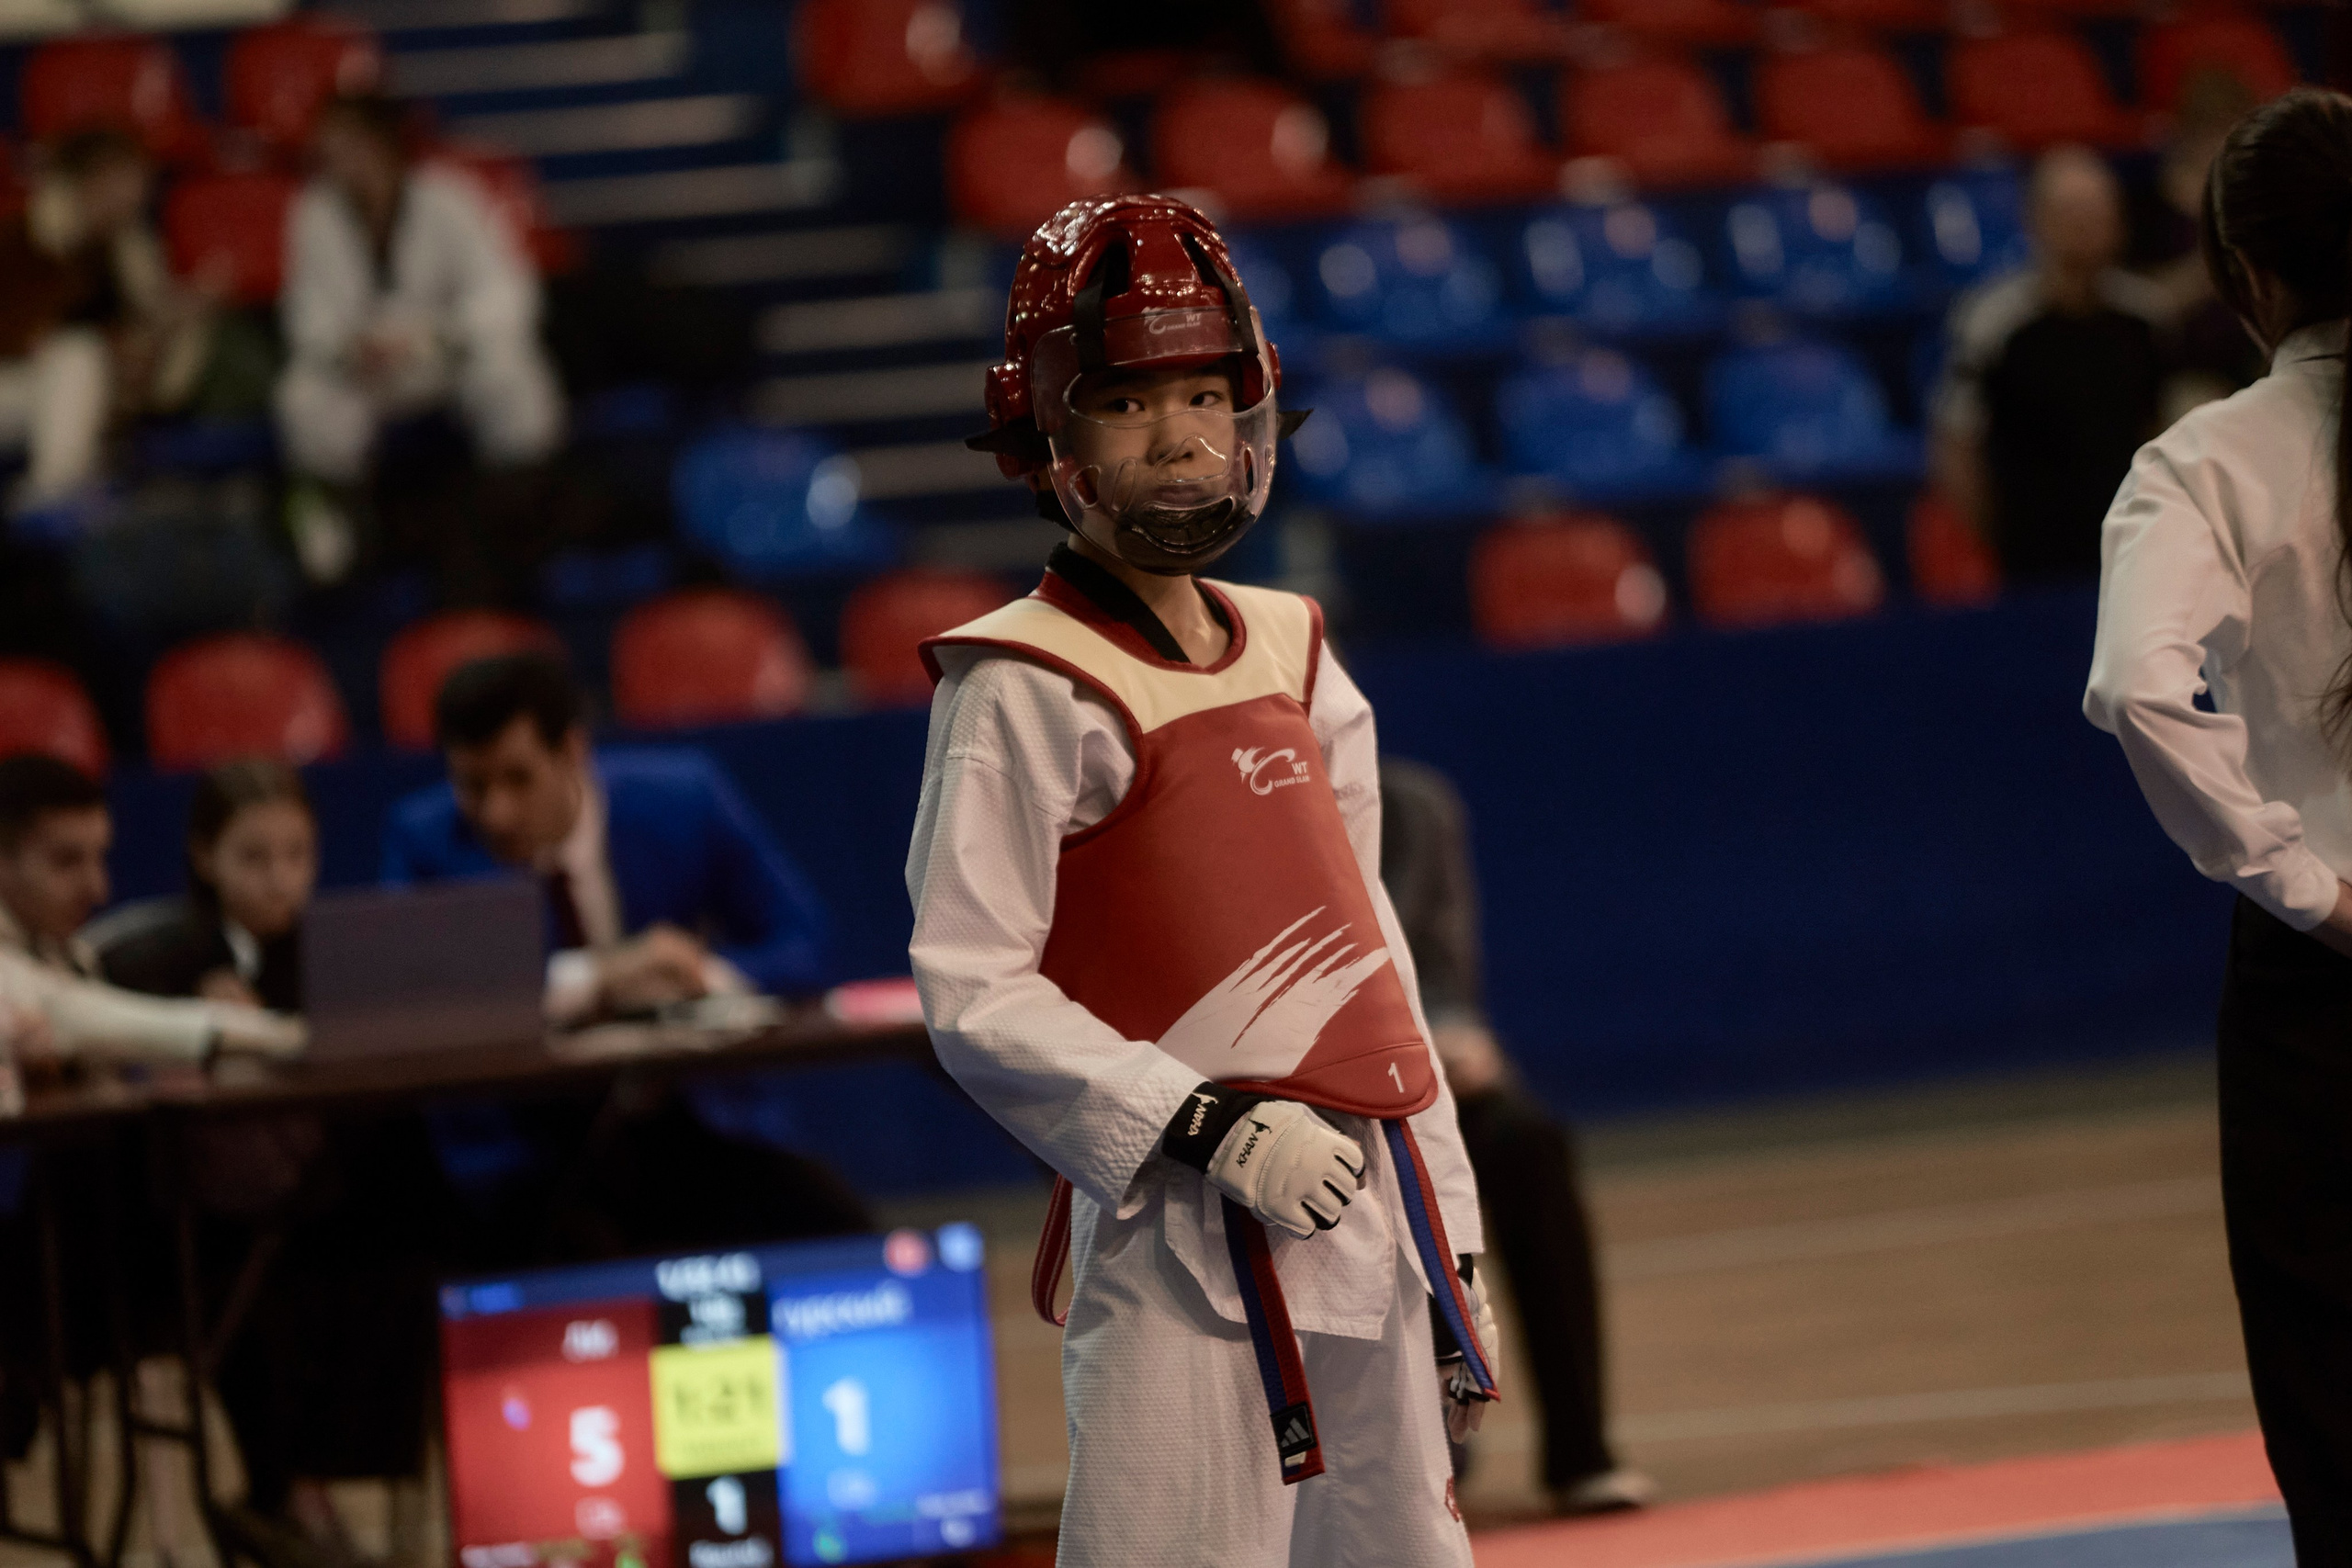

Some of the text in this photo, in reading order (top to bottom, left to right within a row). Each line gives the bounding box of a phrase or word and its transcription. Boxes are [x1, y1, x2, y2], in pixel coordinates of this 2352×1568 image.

[1185, 313, 1202, 322] WT
[1274, 777, 1295, 787] GRAND
[1292, 761, 1306, 774] WT
[1387, 1062, 1405, 1094] 1
[1187, 1104, 1208, 1136] KHAN
[1236, 1133, 1259, 1168] KHAN
[822, 1378, 871, 1455] 1
[569, 1405, 624, 1487] 5
[706, 1476, 748, 1535] 1
